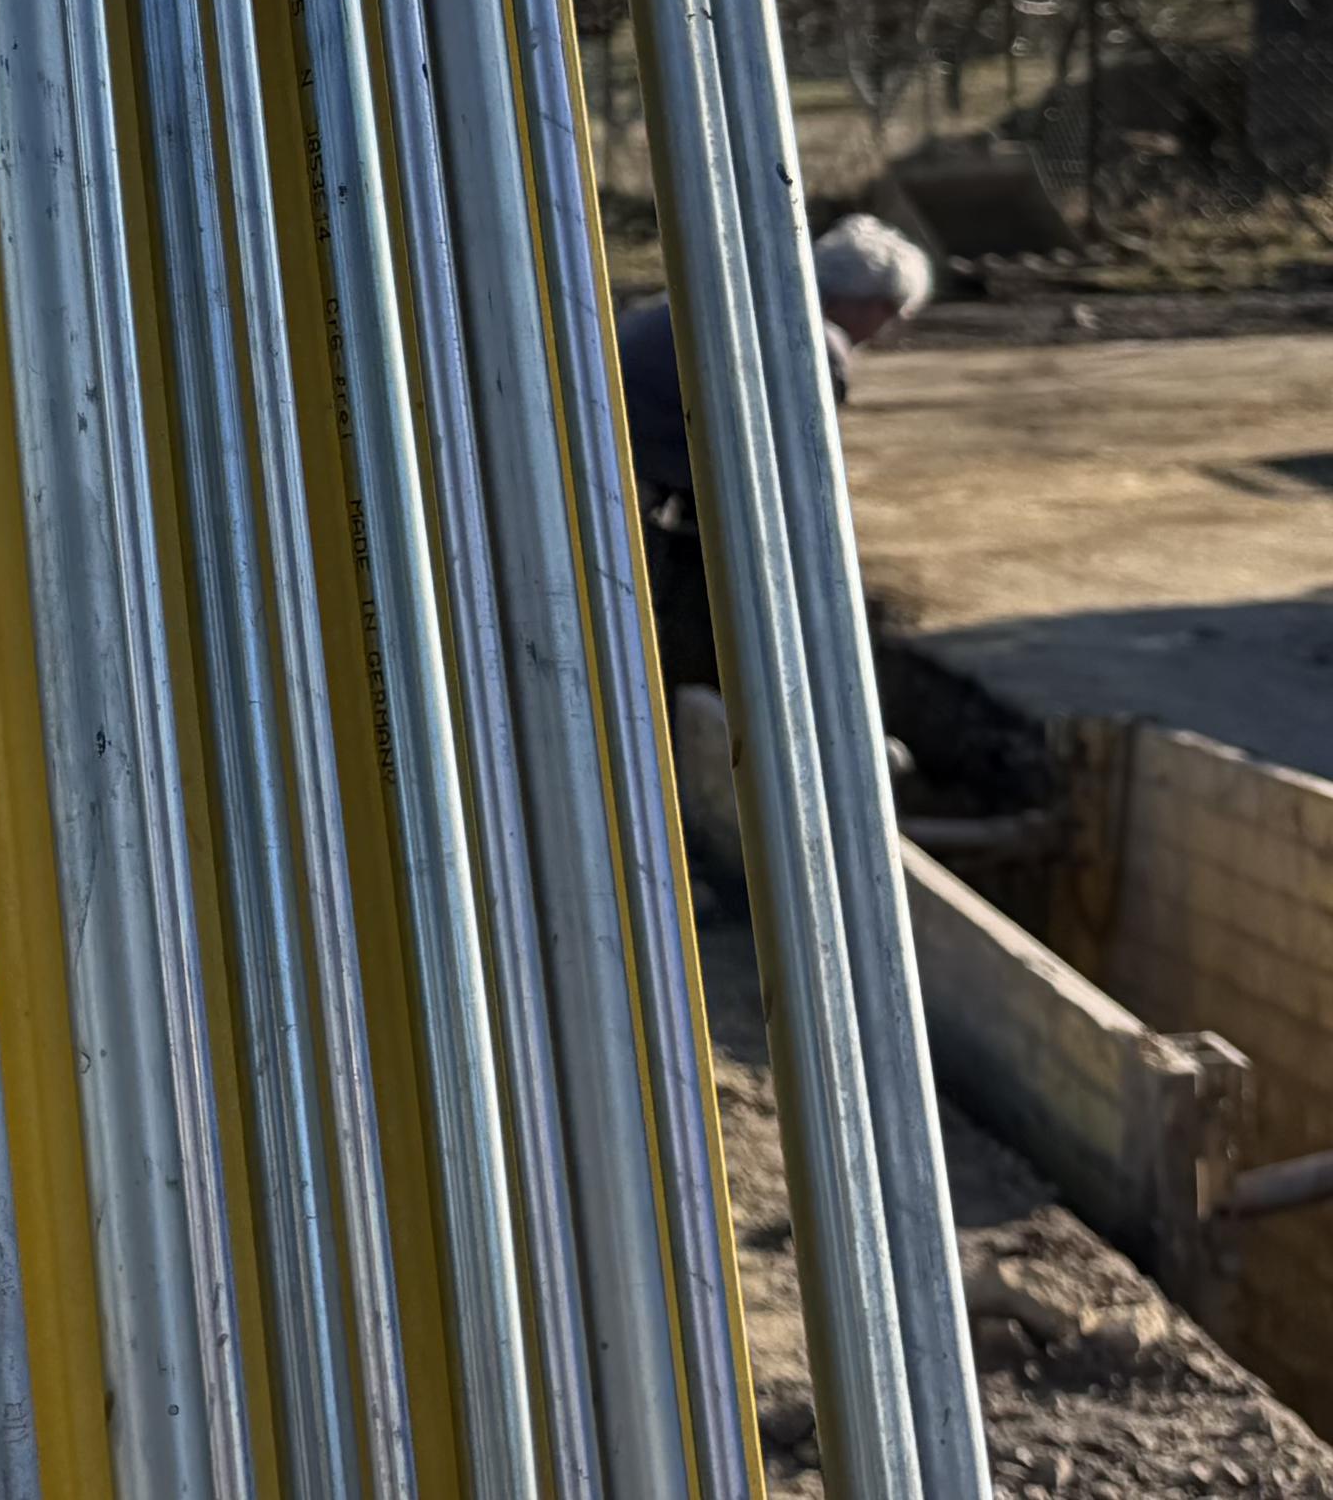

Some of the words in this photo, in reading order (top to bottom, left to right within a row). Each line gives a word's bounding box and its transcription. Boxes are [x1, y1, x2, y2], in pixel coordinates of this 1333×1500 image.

[347, 498, 370, 570] MADE
[361, 597, 378, 632] IN
[367, 651, 399, 786] GERMANY
